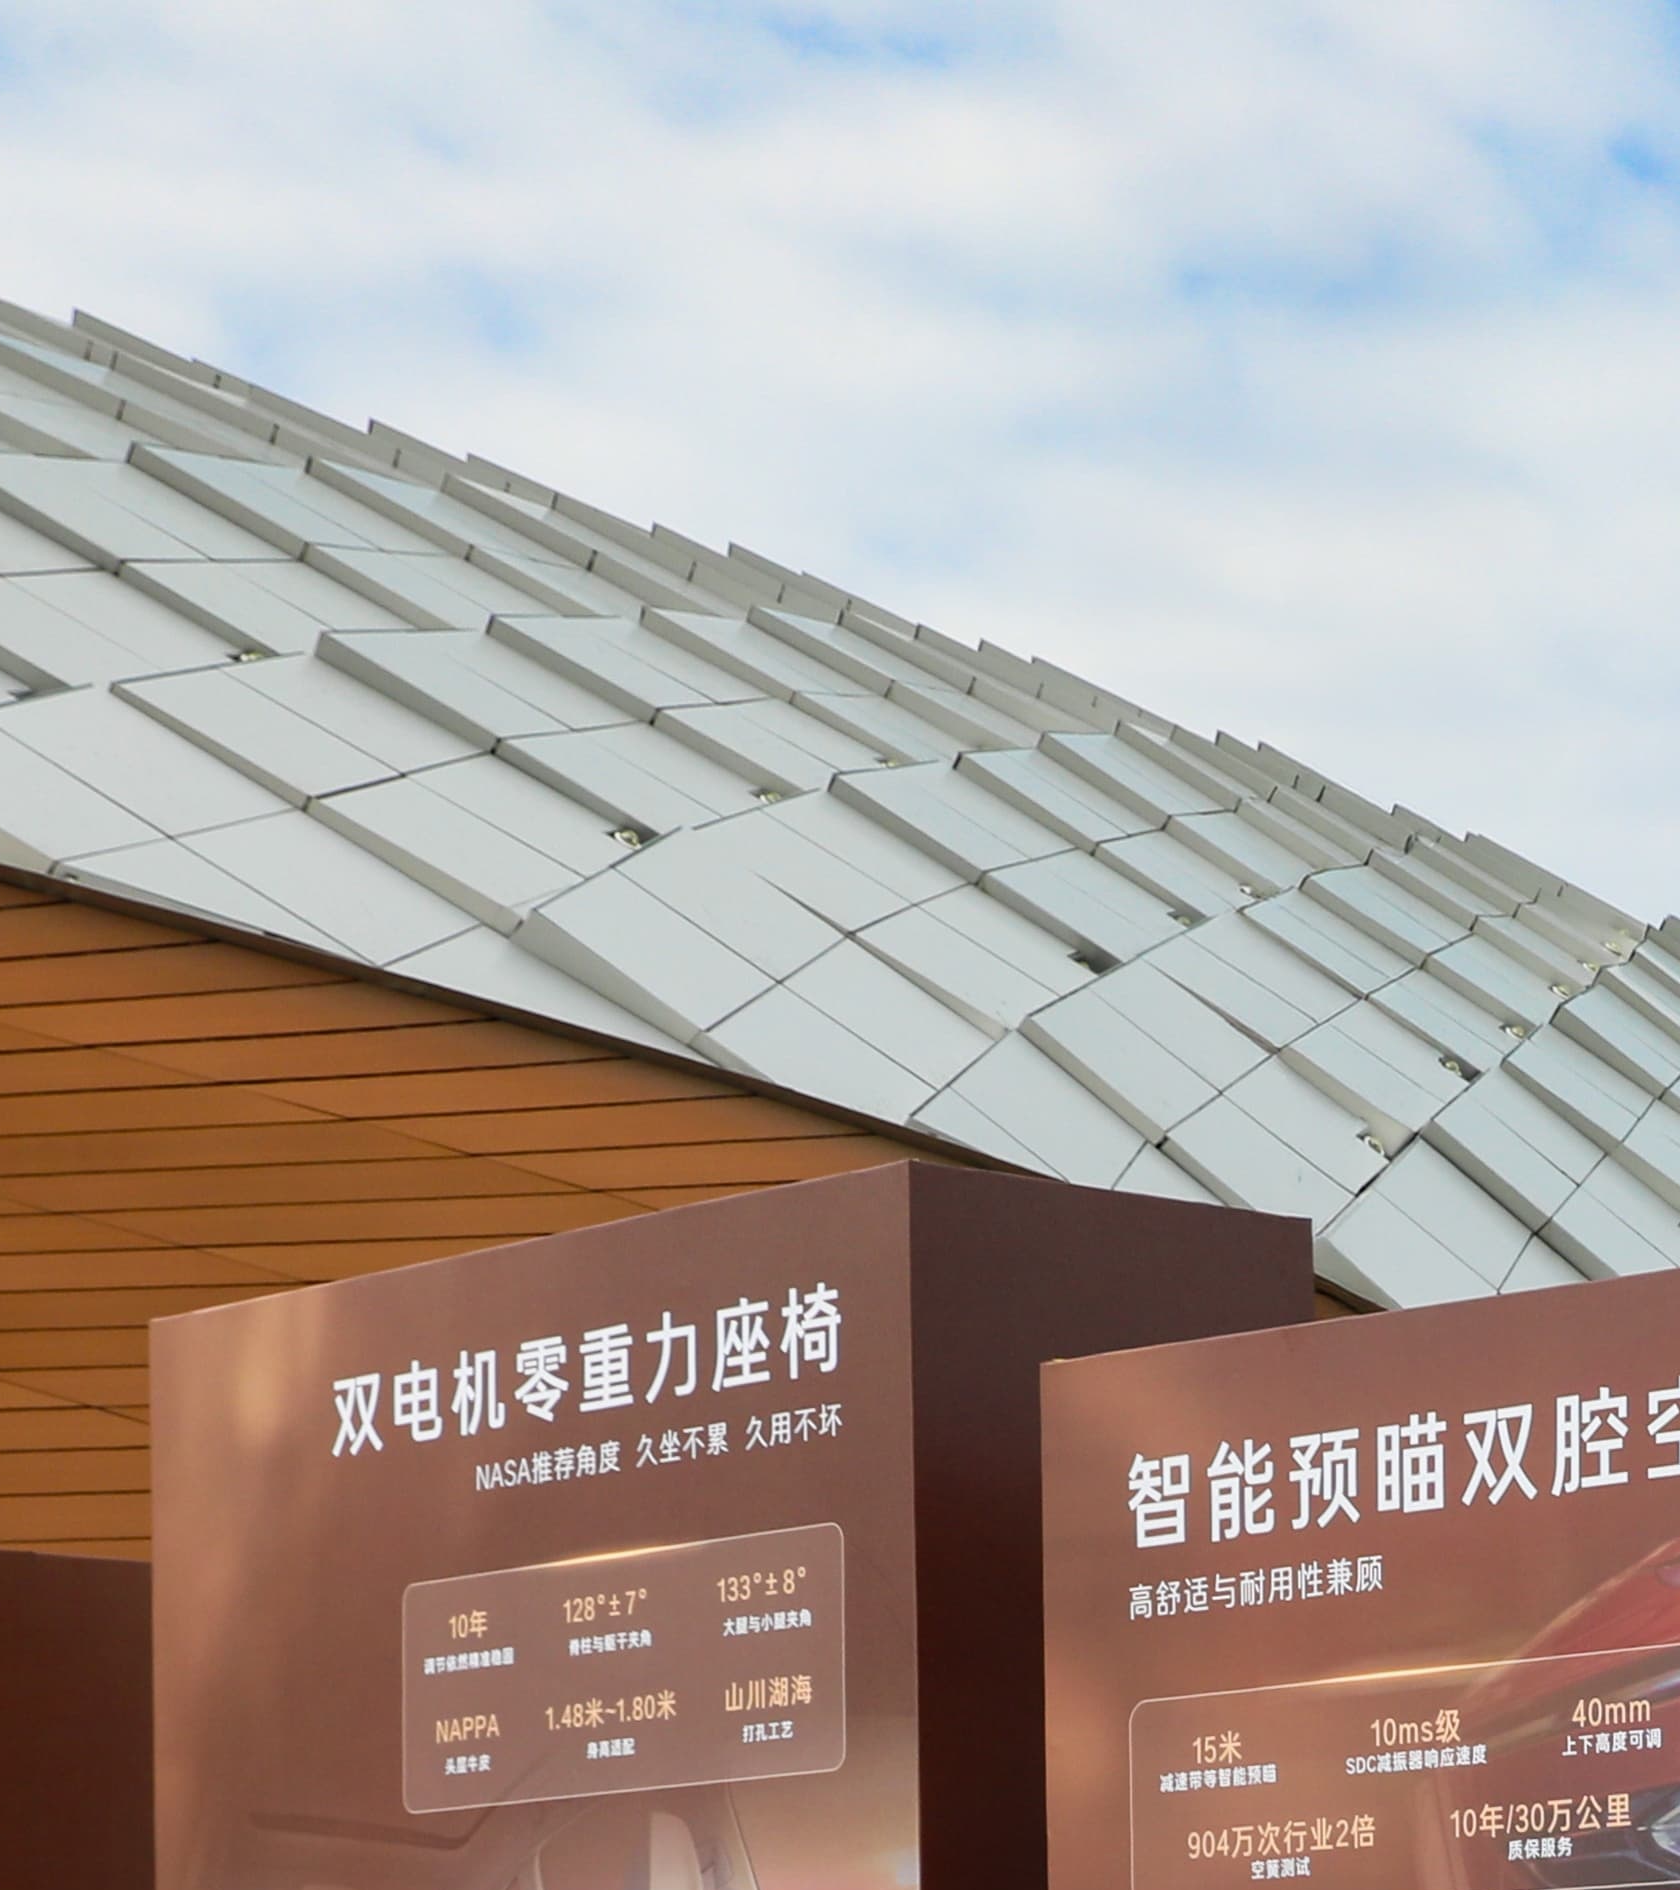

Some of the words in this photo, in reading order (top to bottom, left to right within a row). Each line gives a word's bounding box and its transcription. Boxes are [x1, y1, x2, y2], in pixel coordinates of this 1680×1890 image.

[331, 1281, 842, 1458] 双电机零重力座椅
[475, 1439, 621, 1491] NASA推荐角度
[635, 1421, 729, 1468] 久坐不累
[745, 1403, 843, 1451] 久用不坏
[1128, 1554, 1383, 1621] 高舒适与耐用性兼顾
[448, 1609, 489, 1640] 10年
[724, 1674, 813, 1712] 山川湖海
[435, 1713, 501, 1745] NAPPA
[1370, 1709, 1461, 1747] 10ms级
[1571, 1697, 1651, 1728] 40mm
[742, 1720, 794, 1744] 打孔工艺
[1192, 1730, 1243, 1764] 15米
[1561, 1727, 1662, 1757] 上下高度可调
[1345, 1743, 1488, 1775] SDC减振器响应速度
[1450, 1793, 1632, 1839] 10年/30万公里
[1187, 1813, 1376, 1860] 904万次行业2倍
[1507, 1836, 1573, 1861] 质保服务
[1250, 1855, 1311, 1880] 空簧测试
